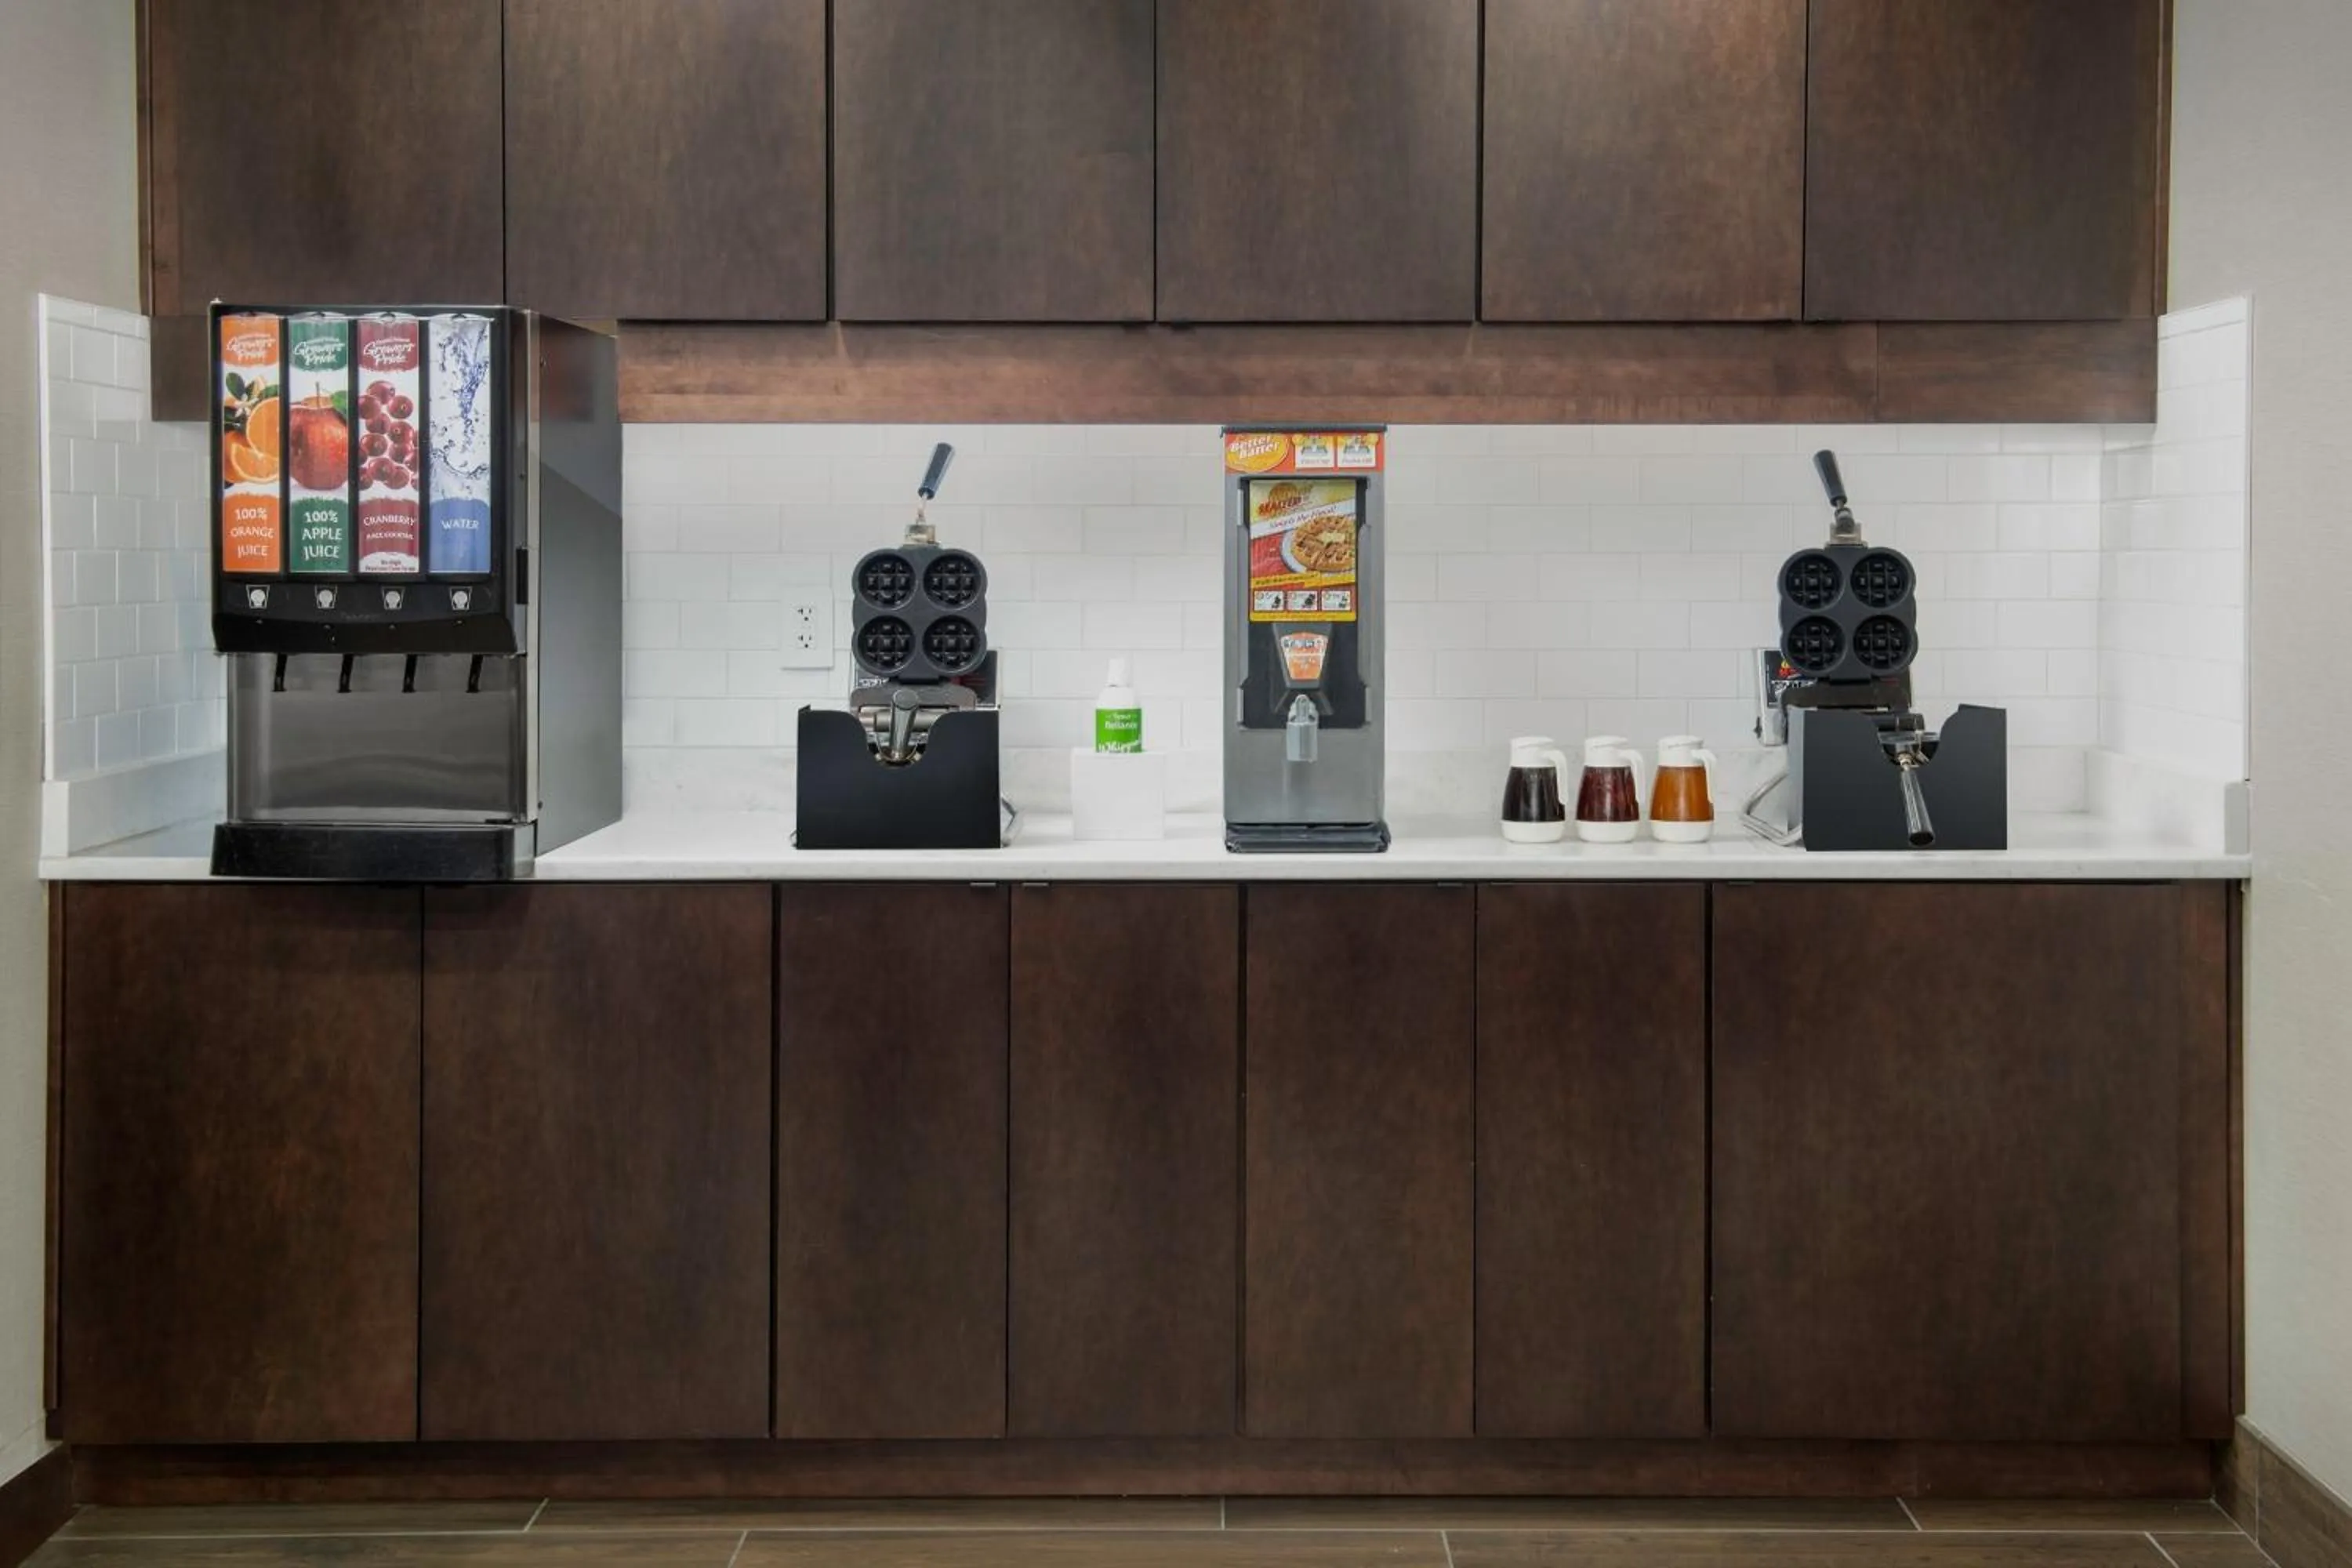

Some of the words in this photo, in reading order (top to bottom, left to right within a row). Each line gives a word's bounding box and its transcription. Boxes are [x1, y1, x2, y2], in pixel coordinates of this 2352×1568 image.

[236, 507, 268, 521] 100%
[303, 510, 339, 523] 100%
[363, 514, 416, 526] CRANBERRY
[441, 518, 480, 530] WATER
[230, 526, 274, 539] ORANGE
[302, 527, 343, 541] APPLE
[238, 545, 270, 559] JUICE
[303, 544, 339, 561] JUICE
